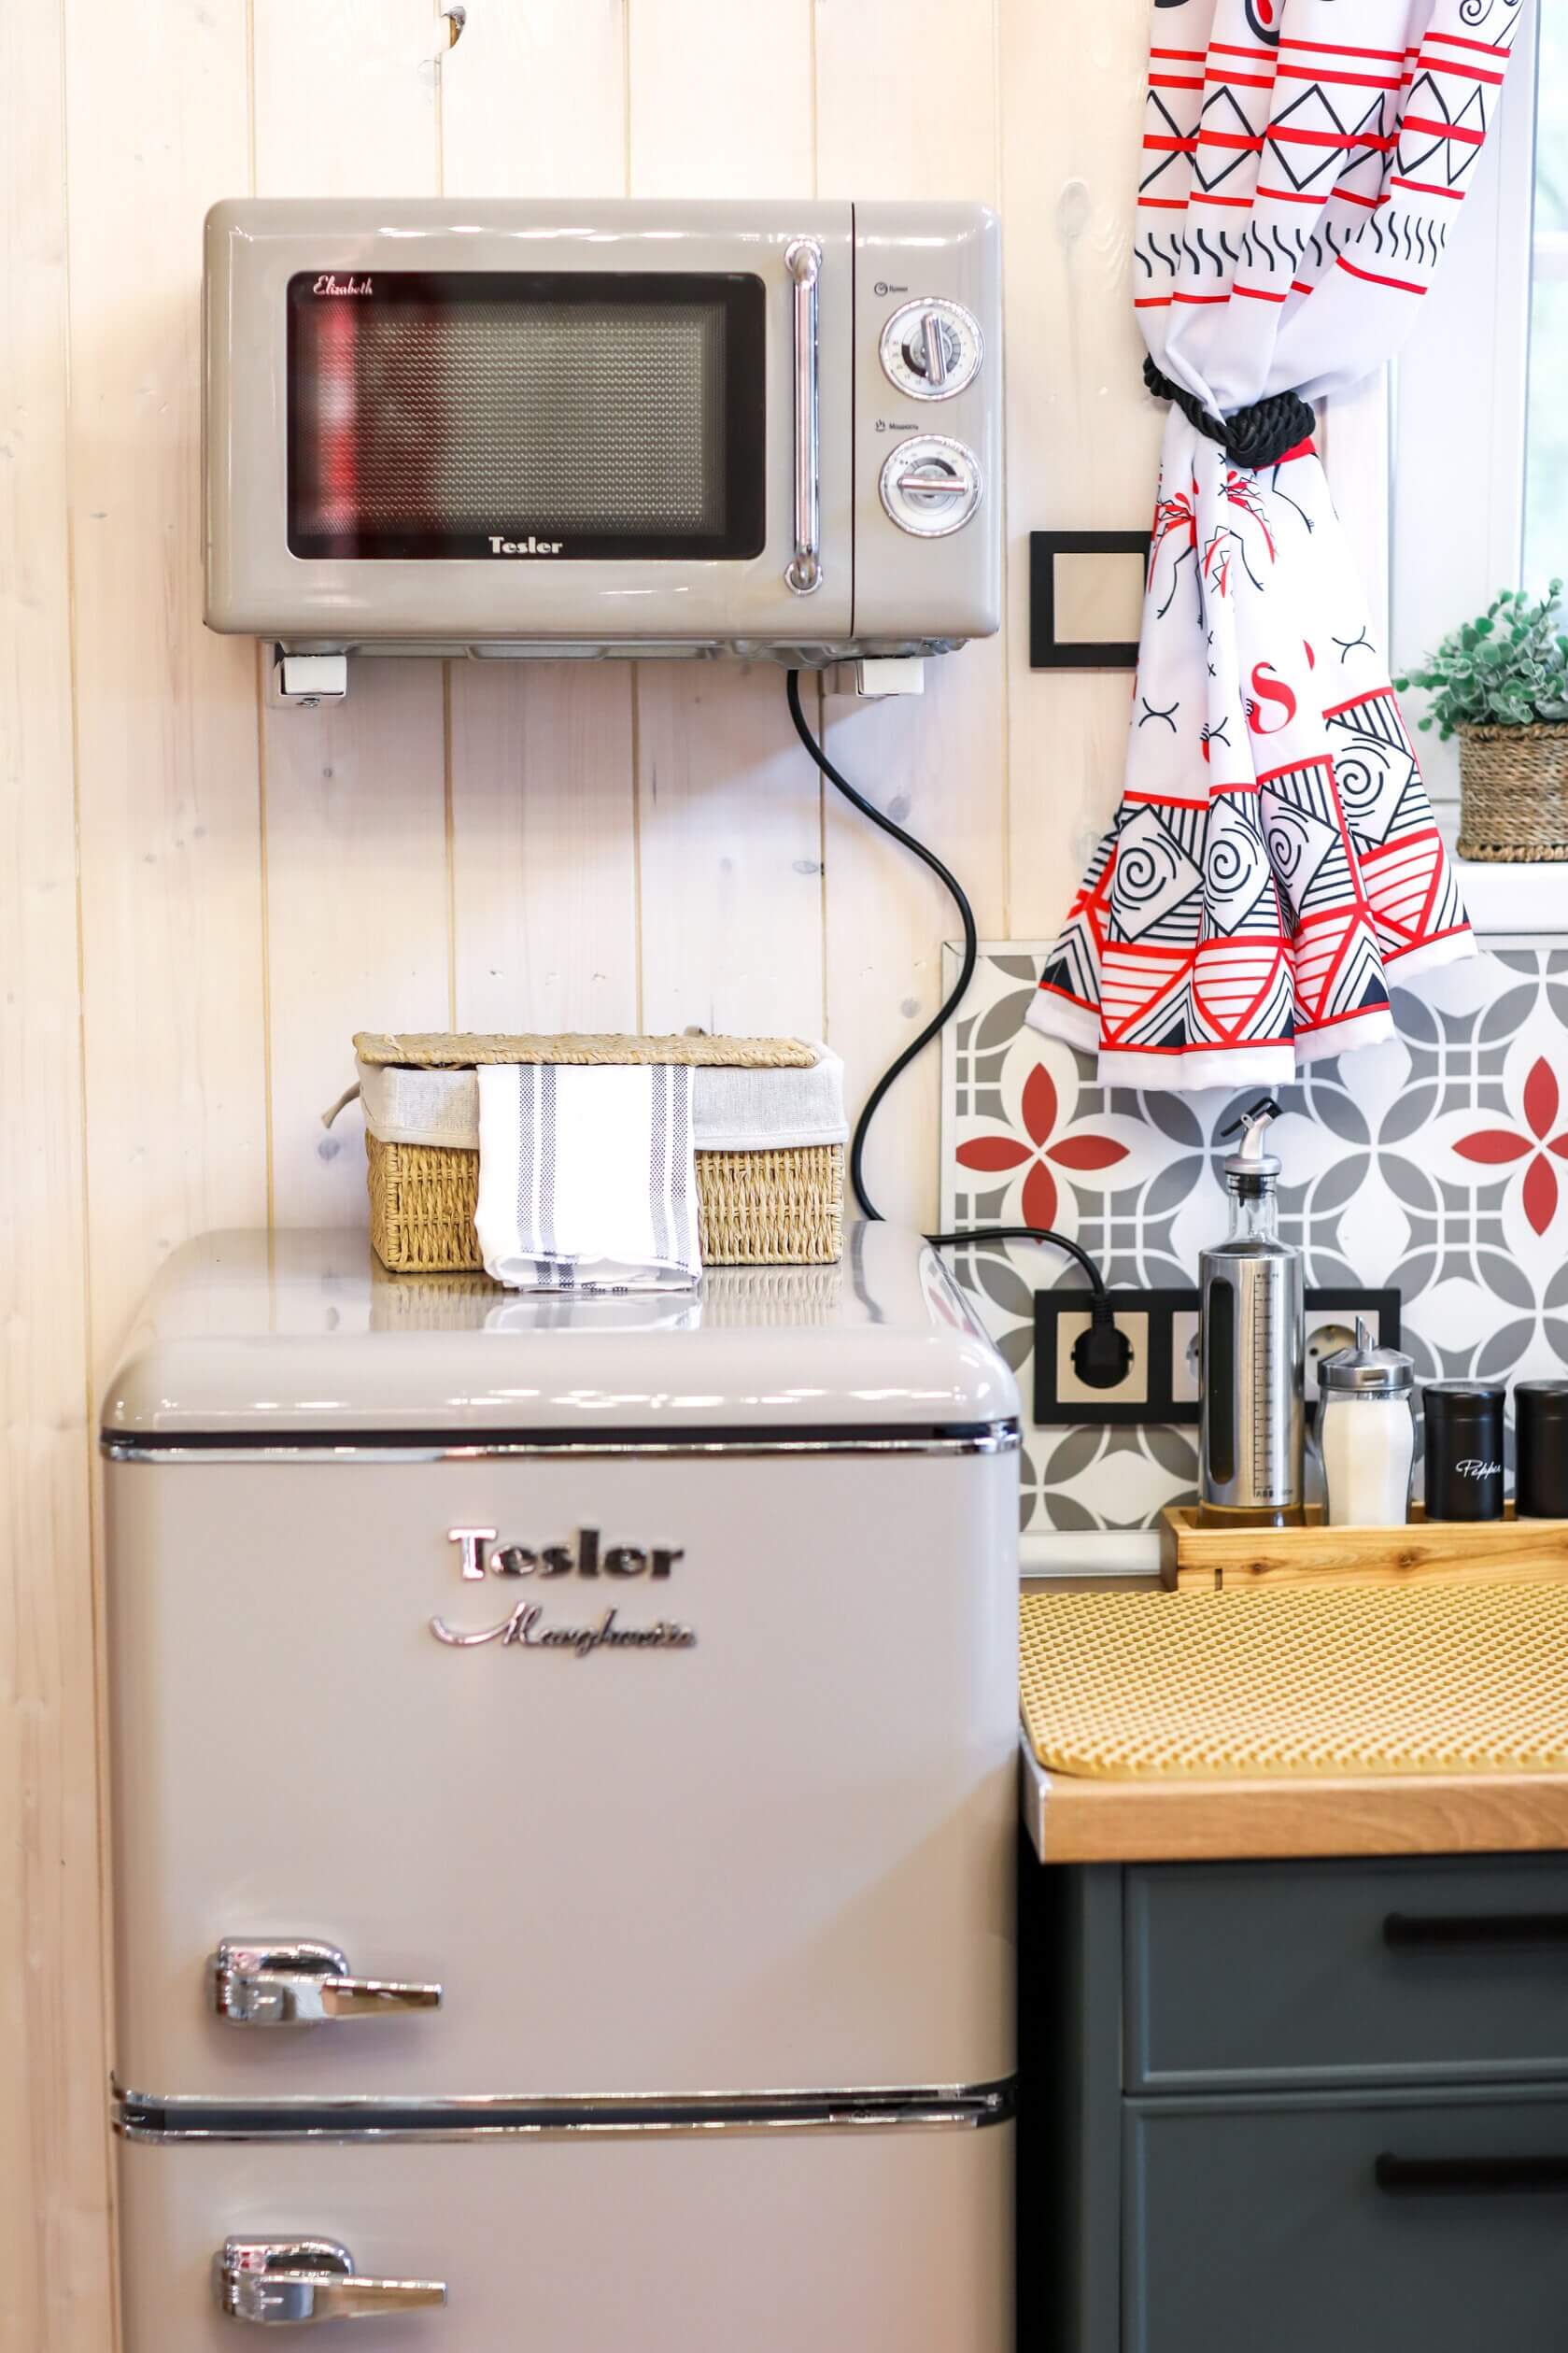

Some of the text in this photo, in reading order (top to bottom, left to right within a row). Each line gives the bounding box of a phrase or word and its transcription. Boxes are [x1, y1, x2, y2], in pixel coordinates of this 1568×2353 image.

[313, 275, 373, 295] Elizabeth
[487, 535, 563, 554] Tesler
[447, 1527, 685, 1580] Tesler
